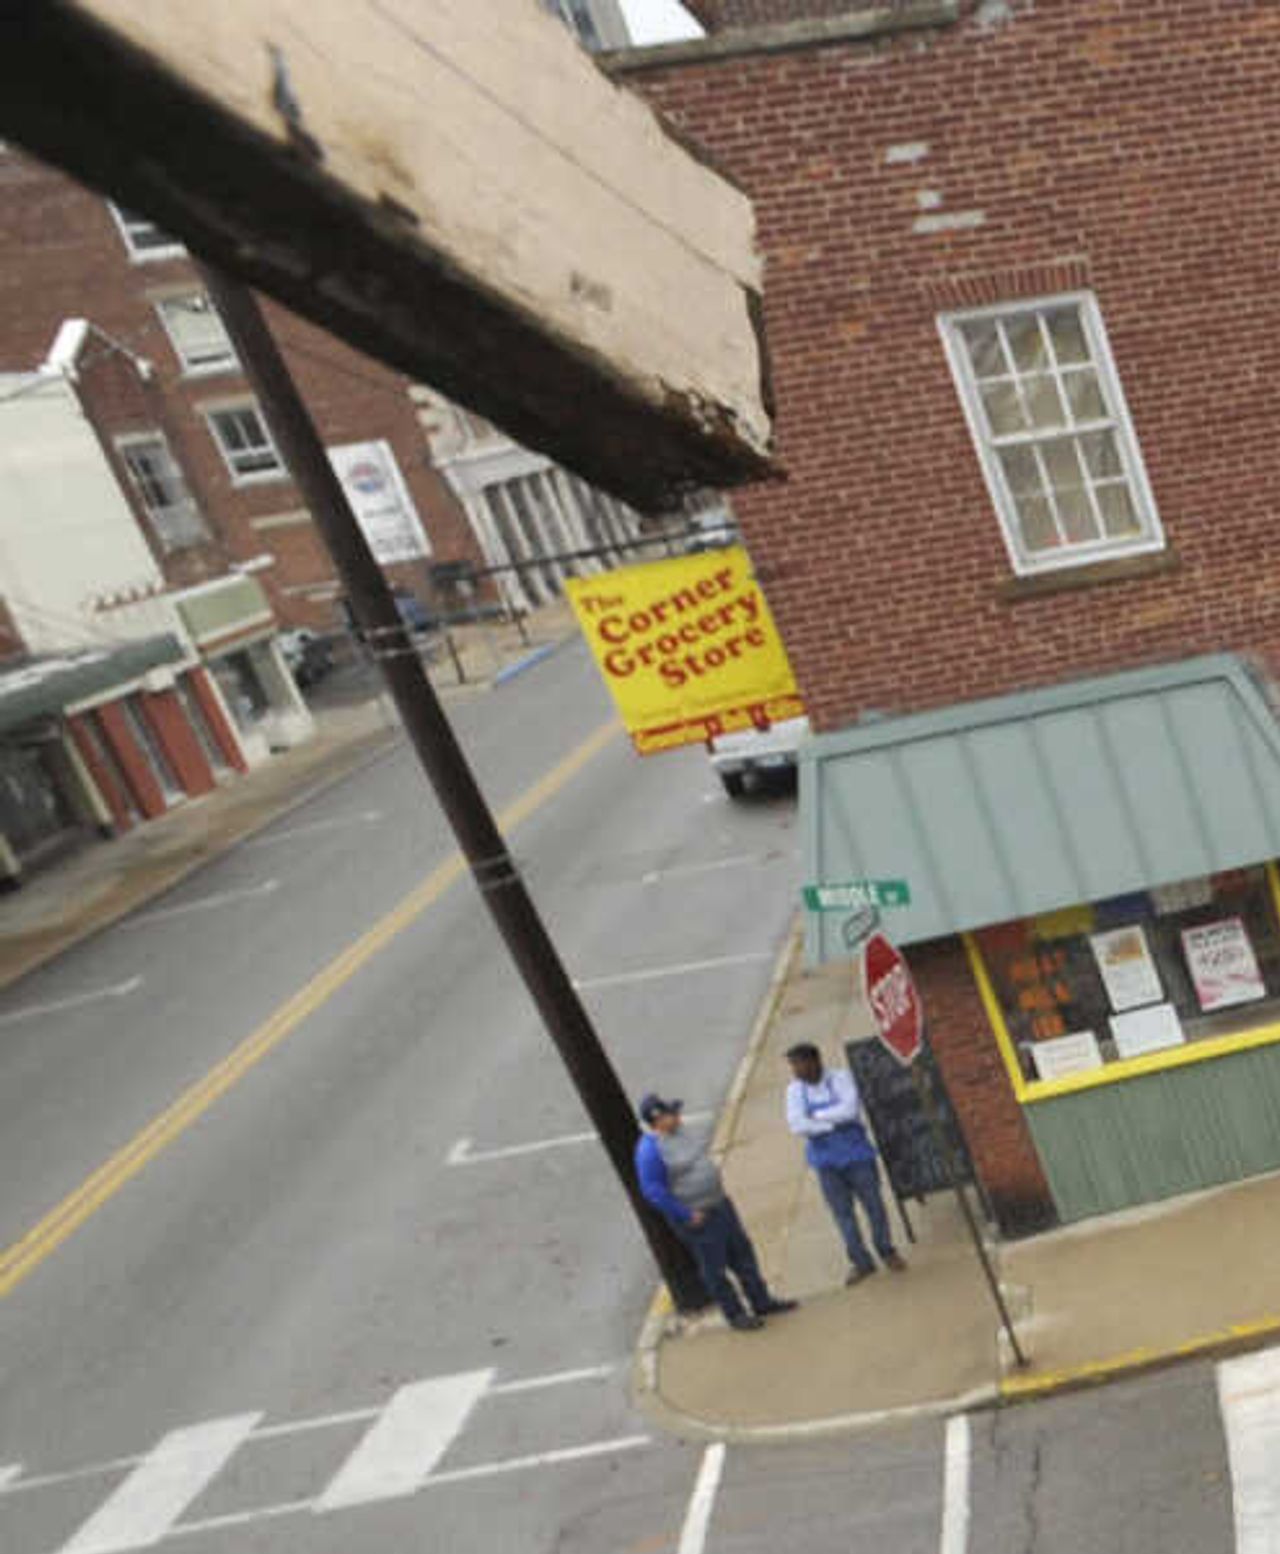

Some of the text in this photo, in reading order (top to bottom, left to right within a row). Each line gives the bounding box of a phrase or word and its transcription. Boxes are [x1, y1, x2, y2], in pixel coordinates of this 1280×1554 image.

[599, 568, 732, 643] Corner
[604, 590, 759, 678] Grocery
[658, 627, 766, 689] Store
[870, 963, 913, 1031] STOP
